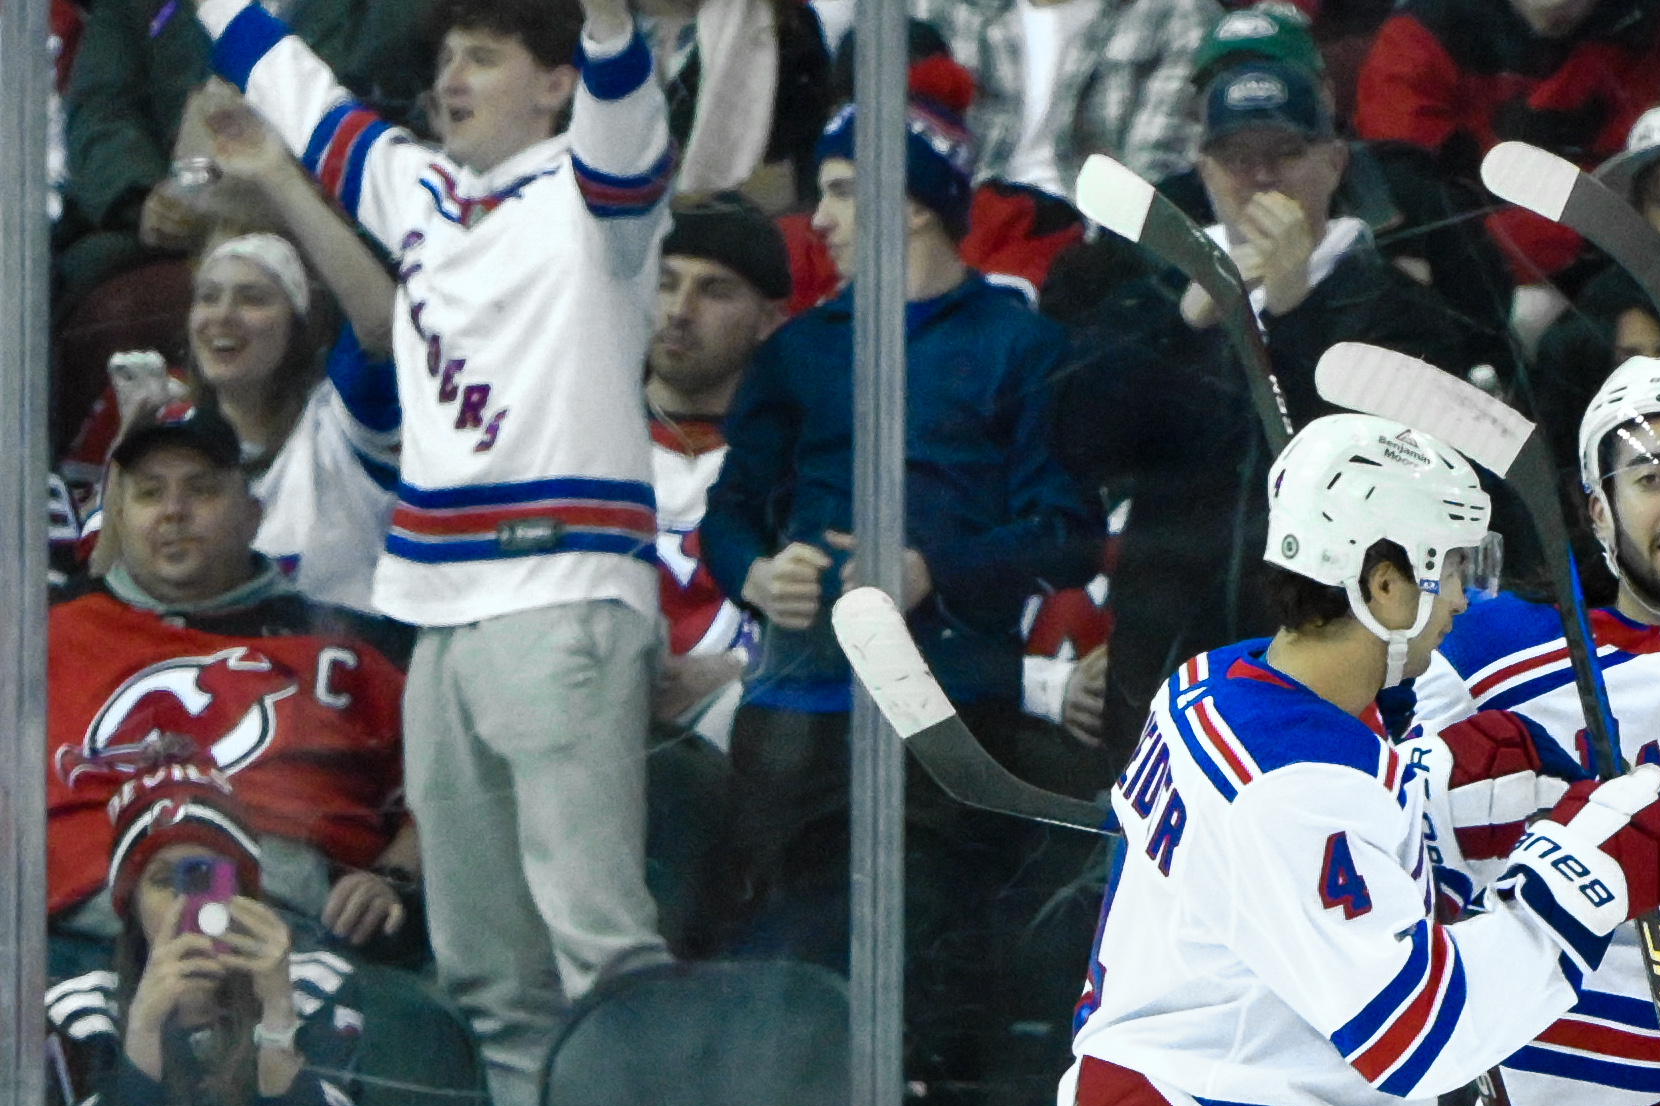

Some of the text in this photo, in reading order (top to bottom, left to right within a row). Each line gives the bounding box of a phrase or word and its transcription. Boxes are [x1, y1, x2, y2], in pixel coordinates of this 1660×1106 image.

[1378, 435, 1431, 465] Benjamin
[314, 647, 359, 709] C
[1318, 831, 1373, 921] 4
